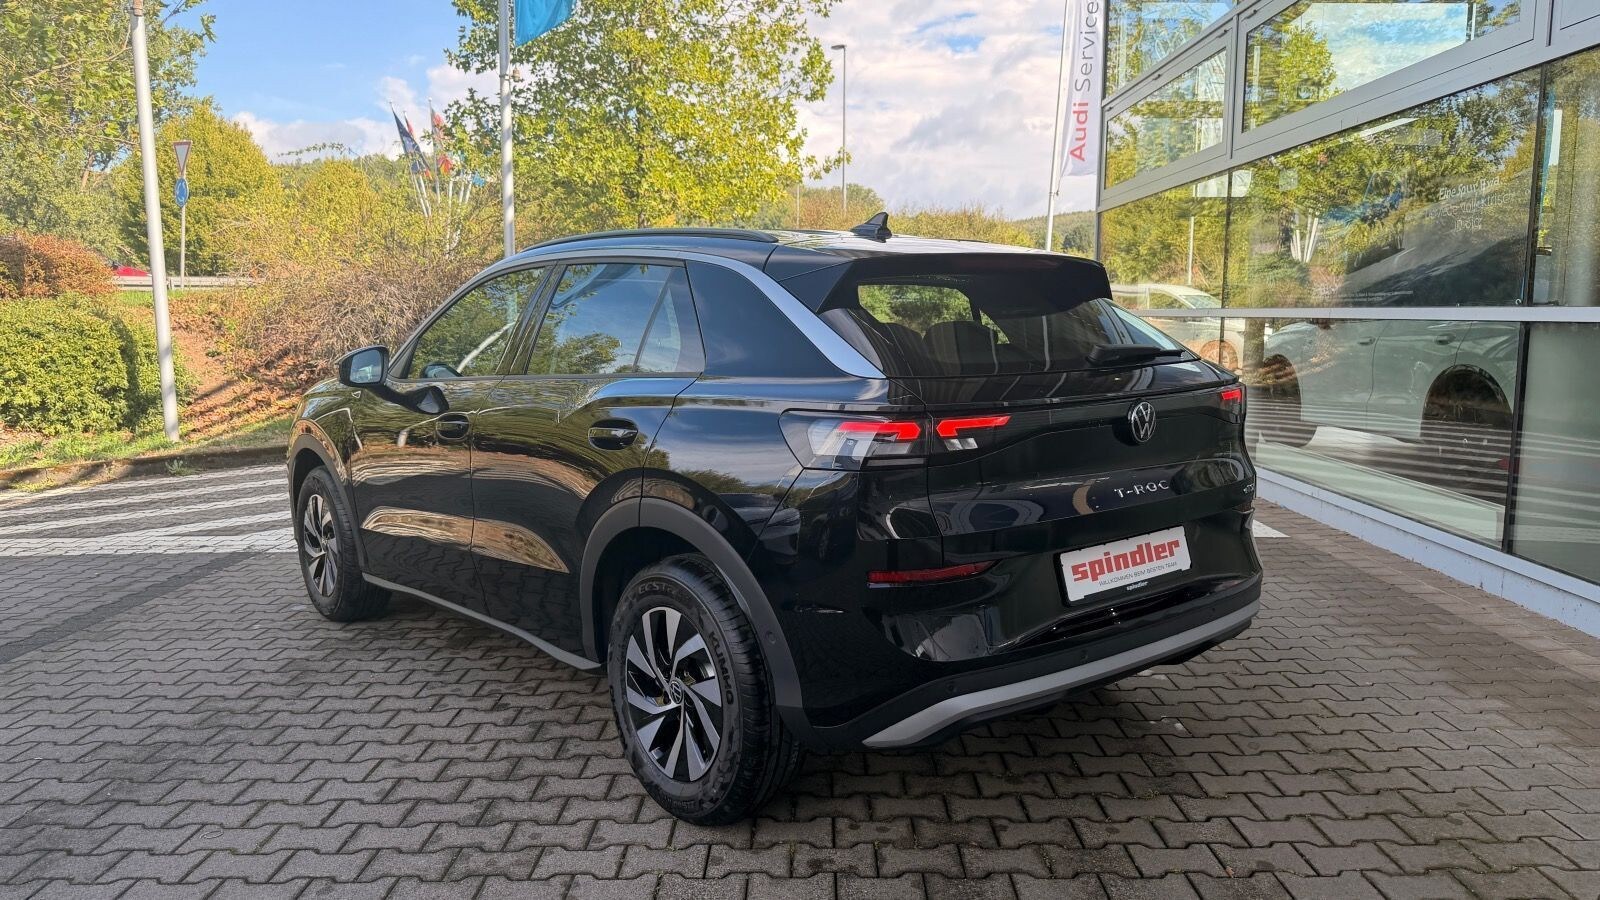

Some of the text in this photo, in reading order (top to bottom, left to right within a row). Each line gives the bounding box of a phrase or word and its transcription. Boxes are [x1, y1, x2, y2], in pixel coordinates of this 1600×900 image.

[1069, 1, 1099, 161] Audi Service
[1113, 479, 1170, 498] T-ROC
[1071, 539, 1180, 583] spindler
[708, 631, 734, 705] KUMHO
